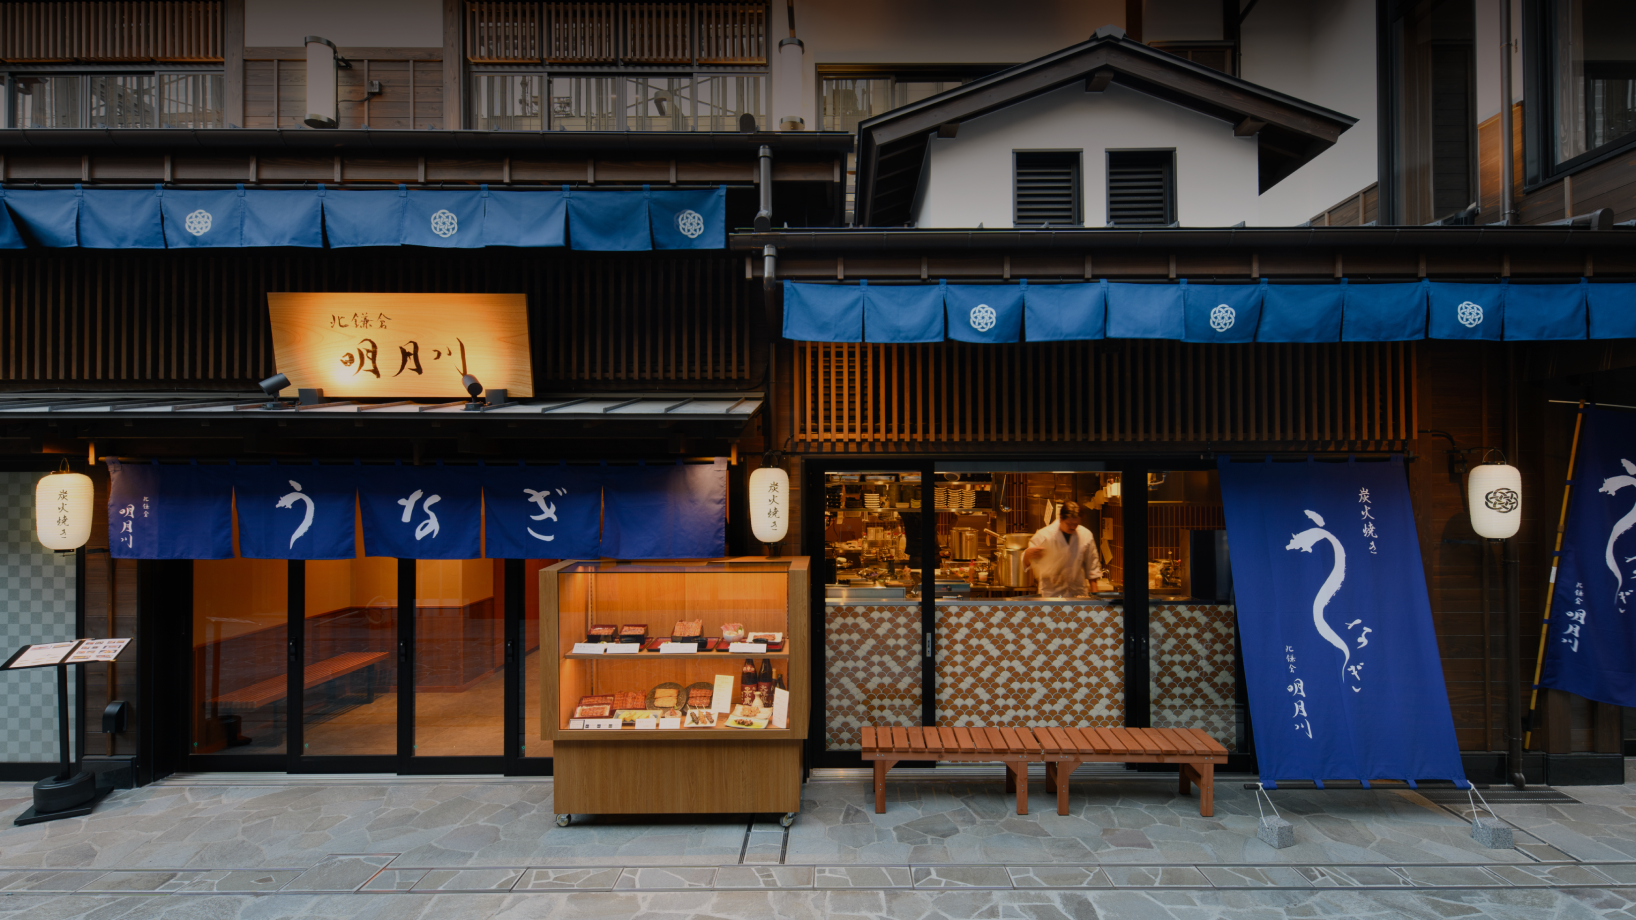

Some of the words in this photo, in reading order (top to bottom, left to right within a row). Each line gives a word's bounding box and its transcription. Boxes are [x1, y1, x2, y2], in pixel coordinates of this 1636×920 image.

[329, 312, 392, 329] 北鎌倉
[339, 337, 468, 379] 明月川
[56, 489, 70, 539] 炭火焼き
[118, 503, 135, 549] 明月川
[275, 479, 568, 550] うなぎ
[767, 481, 780, 531] 炭火焼き
[1358, 487, 1379, 555] 炭火焼き
[1598, 457, 1636, 614] うぎ
[1285, 509, 1373, 693] うなぎ
[1561, 608, 1587, 653] 明月川
[1286, 678, 1313, 740] 明月川
